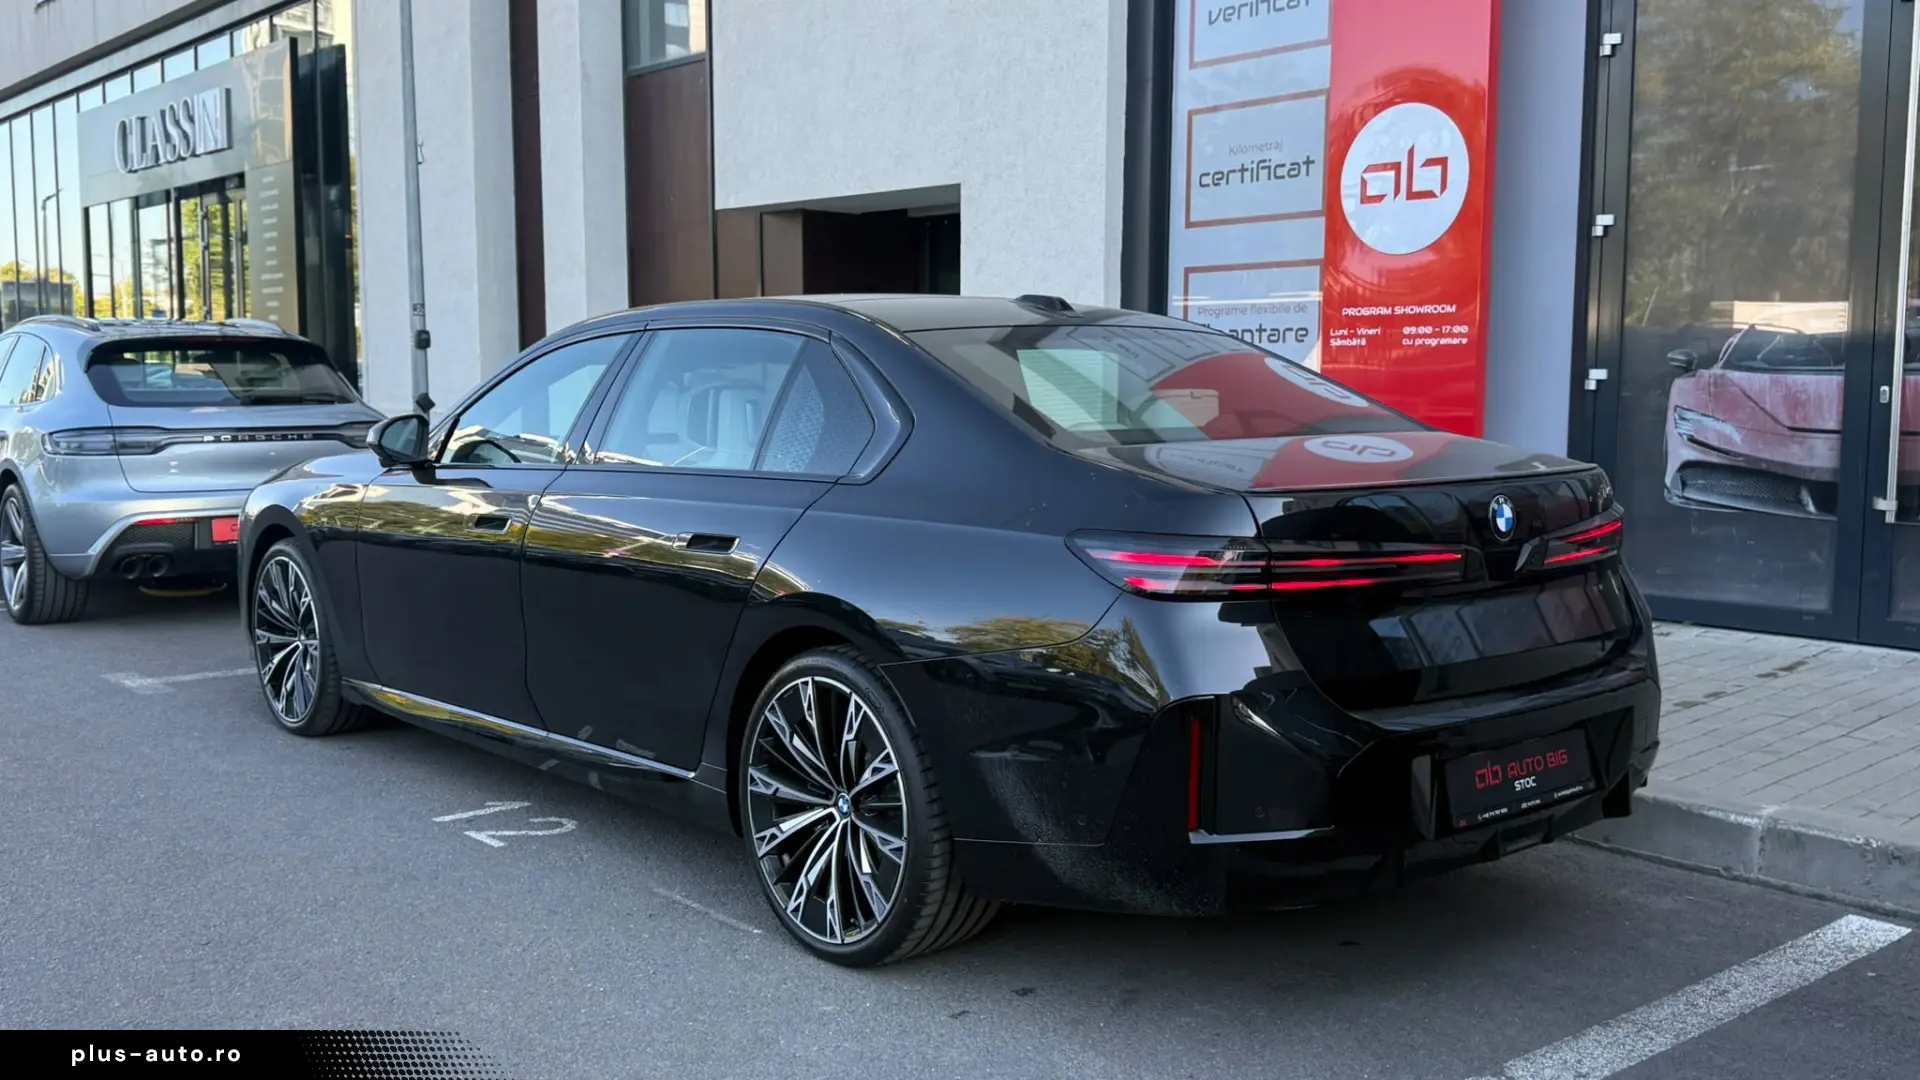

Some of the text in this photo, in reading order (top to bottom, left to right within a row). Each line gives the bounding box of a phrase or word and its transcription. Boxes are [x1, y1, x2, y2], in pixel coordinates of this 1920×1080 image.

[1228, 138, 1284, 156] Kilometraj
[1198, 155, 1316, 188] certificat
[1197, 302, 1308, 319] Programe flexibile de
[1341, 304, 1457, 317] PROGRAM SHOWROOM
[1330, 328, 1348, 336] Luni
[1356, 327, 1381, 336] Vineri
[1402, 325, 1433, 335] 09:00
[1442, 325, 1469, 334] 17:00
[1402, 337, 1468, 348] cu programare
[203, 433, 314, 442] PORSCHE
[1507, 756, 1545, 779] AUTO
[1547, 750, 1569, 768] BIG
[1514, 776, 1537, 791] STOC
